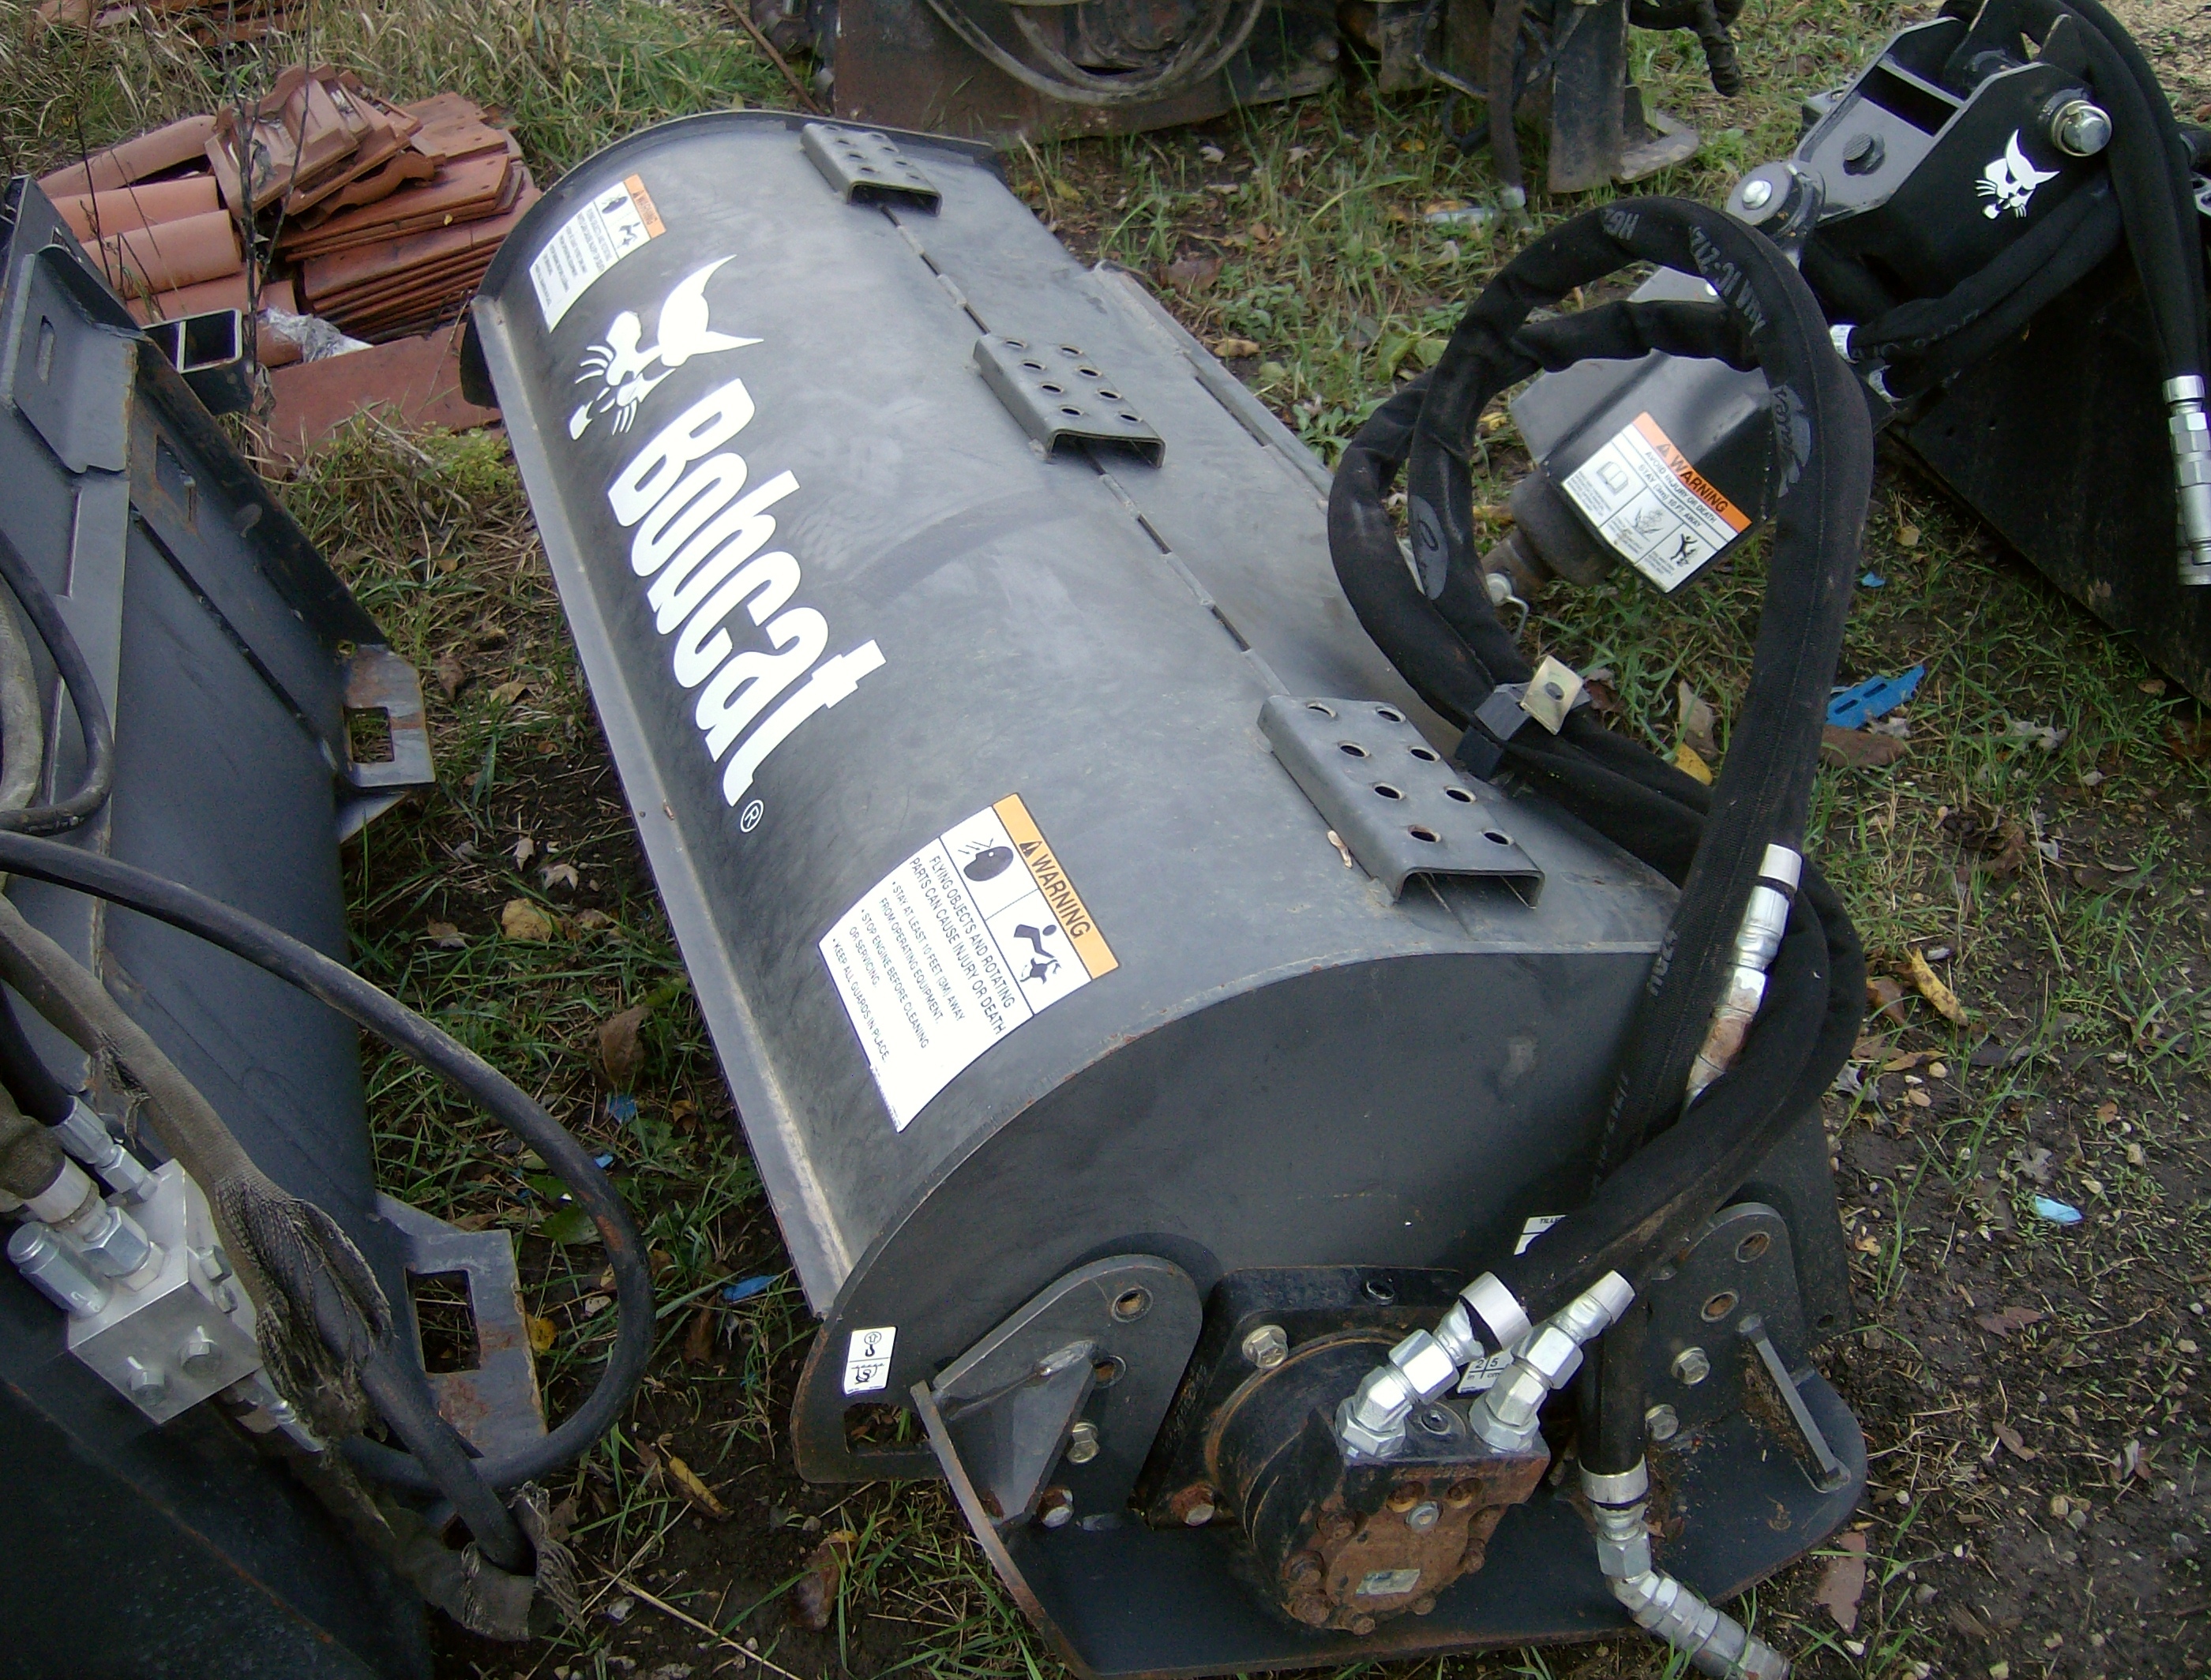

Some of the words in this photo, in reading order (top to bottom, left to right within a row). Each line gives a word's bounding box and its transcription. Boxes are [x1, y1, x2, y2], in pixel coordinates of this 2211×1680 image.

[1639, 464, 1657, 482] STAY
[1684, 513, 1702, 527] AWAY
[1645, 452, 1666, 474] AVOID
[1665, 474, 1687, 497] INJURY
[1687, 497, 1698, 506] OR
[1696, 504, 1717, 523] DEATH
[1670, 455, 1728, 512] WARNING
[608, 378, 886, 807] Bobcat
[893, 885, 908, 906] STAY
[903, 906, 914, 917] AT
[1031, 853, 1090, 939] WARNING
[849, 926, 859, 941] OR
[879, 898, 895, 924] FROM
[891, 922, 918, 970] OPERATING
[908, 916, 927, 943] LEAST
[910, 857, 932, 889] PARTS
[925, 887, 943, 910] CAN
[936, 909, 960, 944] CAUSE
[952, 941, 979, 981] INJURY
[972, 980, 988, 999] OR
[980, 996, 1006, 1035] DEATH
[922, 943, 932, 955] 10
[929, 855, 953, 890] FLYING
[947, 888, 977, 934] OBJECTS
[969, 933, 988, 956] AND
[982, 955, 1015, 1008] ROTATING
[834, 942, 847, 964] KEEP
[843, 966, 854, 983] ALL
[850, 981, 871, 1019] GUARDS
[867, 1017, 876, 1029] IN
[862, 913, 877, 934] STOP
[872, 935, 892, 969] ENGINE
[887, 966, 908, 1003] BEFORE
[903, 1002, 929, 1048] CLEANING
[927, 953, 943, 977] FEET
[948, 996, 966, 1021] AWAY
[1475, 1359, 1485, 1369] 2
[1490, 1358, 1499, 1367] 5
